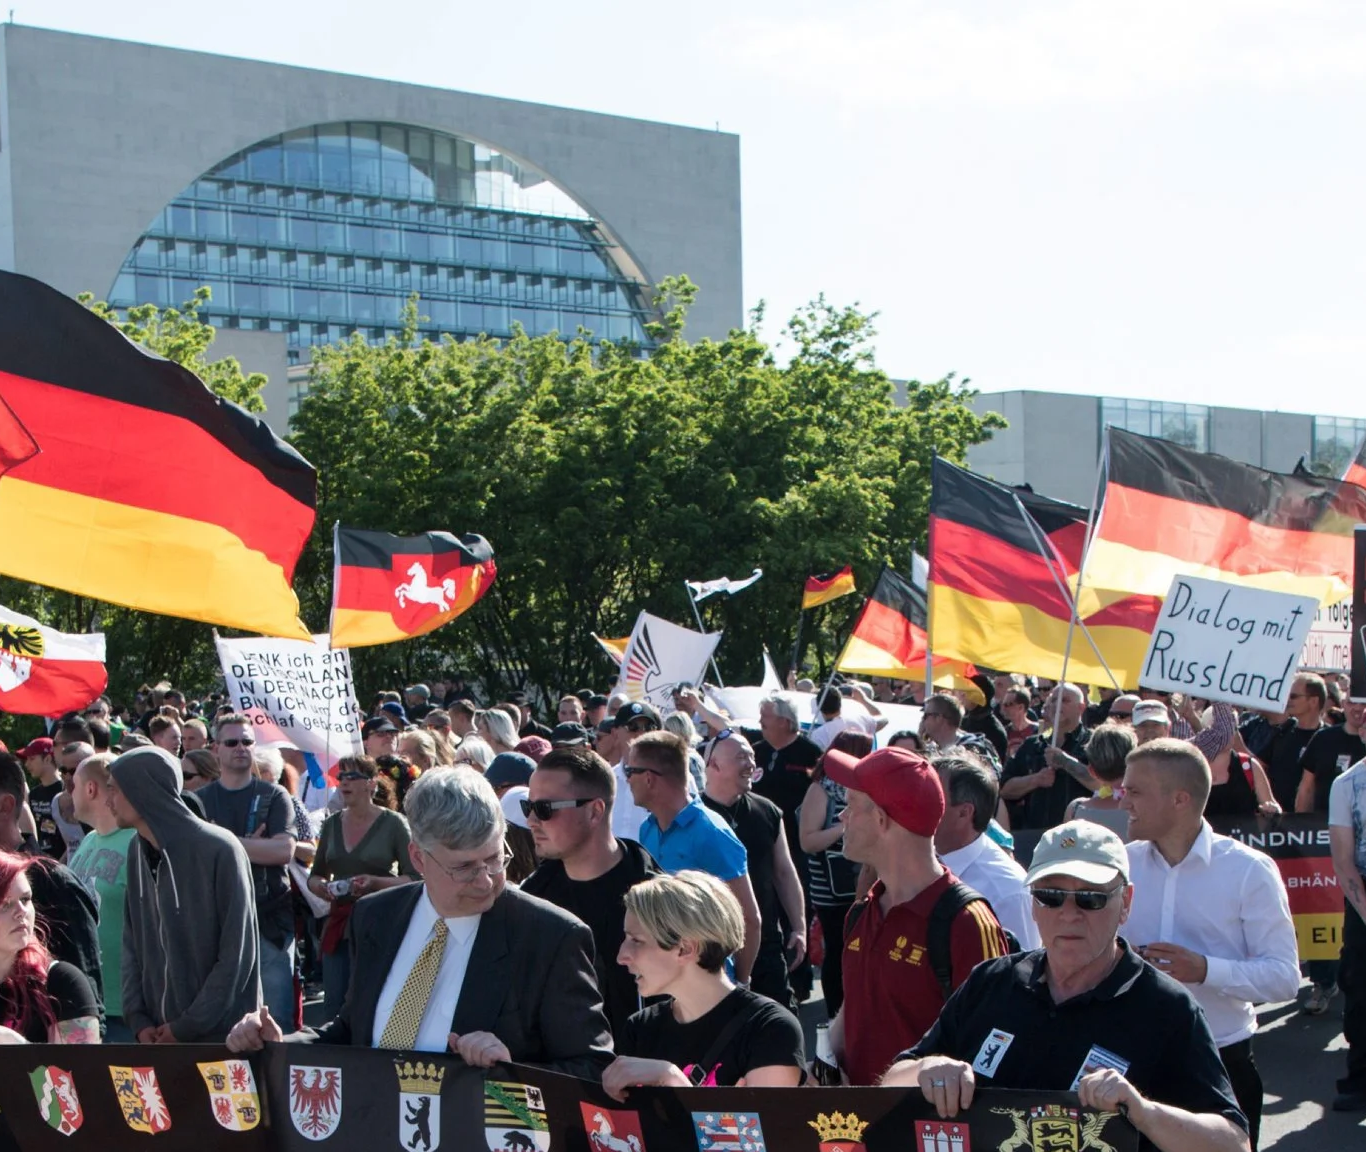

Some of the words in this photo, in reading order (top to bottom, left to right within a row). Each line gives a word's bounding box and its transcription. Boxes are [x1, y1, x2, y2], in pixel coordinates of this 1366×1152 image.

[1168, 582, 1256, 644] Dialog
[1262, 605, 1304, 641] mit
[1145, 629, 1296, 702] Russland
